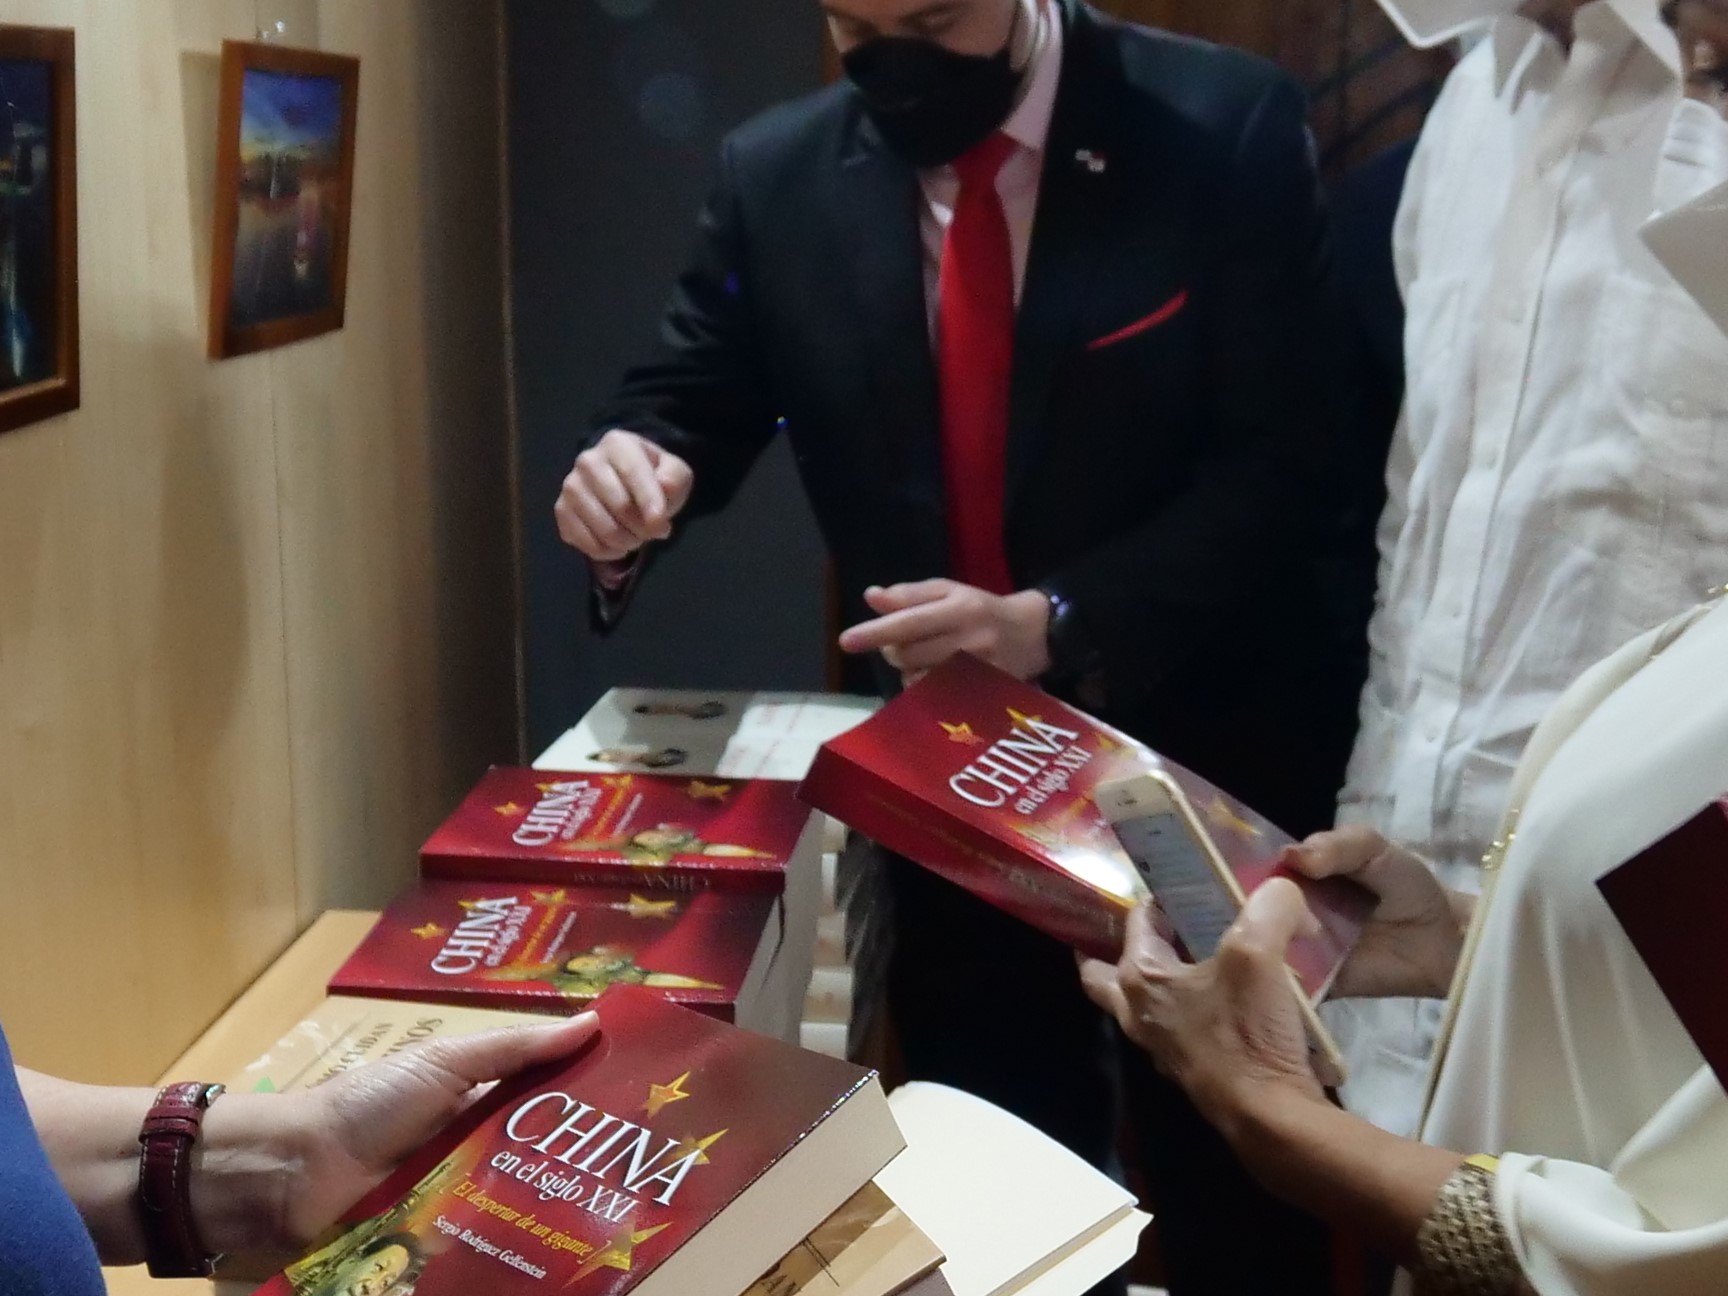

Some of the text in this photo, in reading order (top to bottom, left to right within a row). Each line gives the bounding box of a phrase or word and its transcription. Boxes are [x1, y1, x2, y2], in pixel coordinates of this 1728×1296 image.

[949, 718, 1079, 807] CHINA
[1053, 745, 1092, 773] XXI
[512, 780, 589, 846] CHINA
[1014, 798, 1038, 815] en
[1025, 785, 1049, 803] el
[431, 896, 518, 974] CHINA
[506, 1091, 702, 1206] CHINA
[471, 1189, 522, 1222] despertar
[515, 1213, 535, 1230] de
[530, 1222, 551, 1238] un
[491, 1151, 642, 1223] en el siglo XXI
[432, 1215, 461, 1235] Sergio
